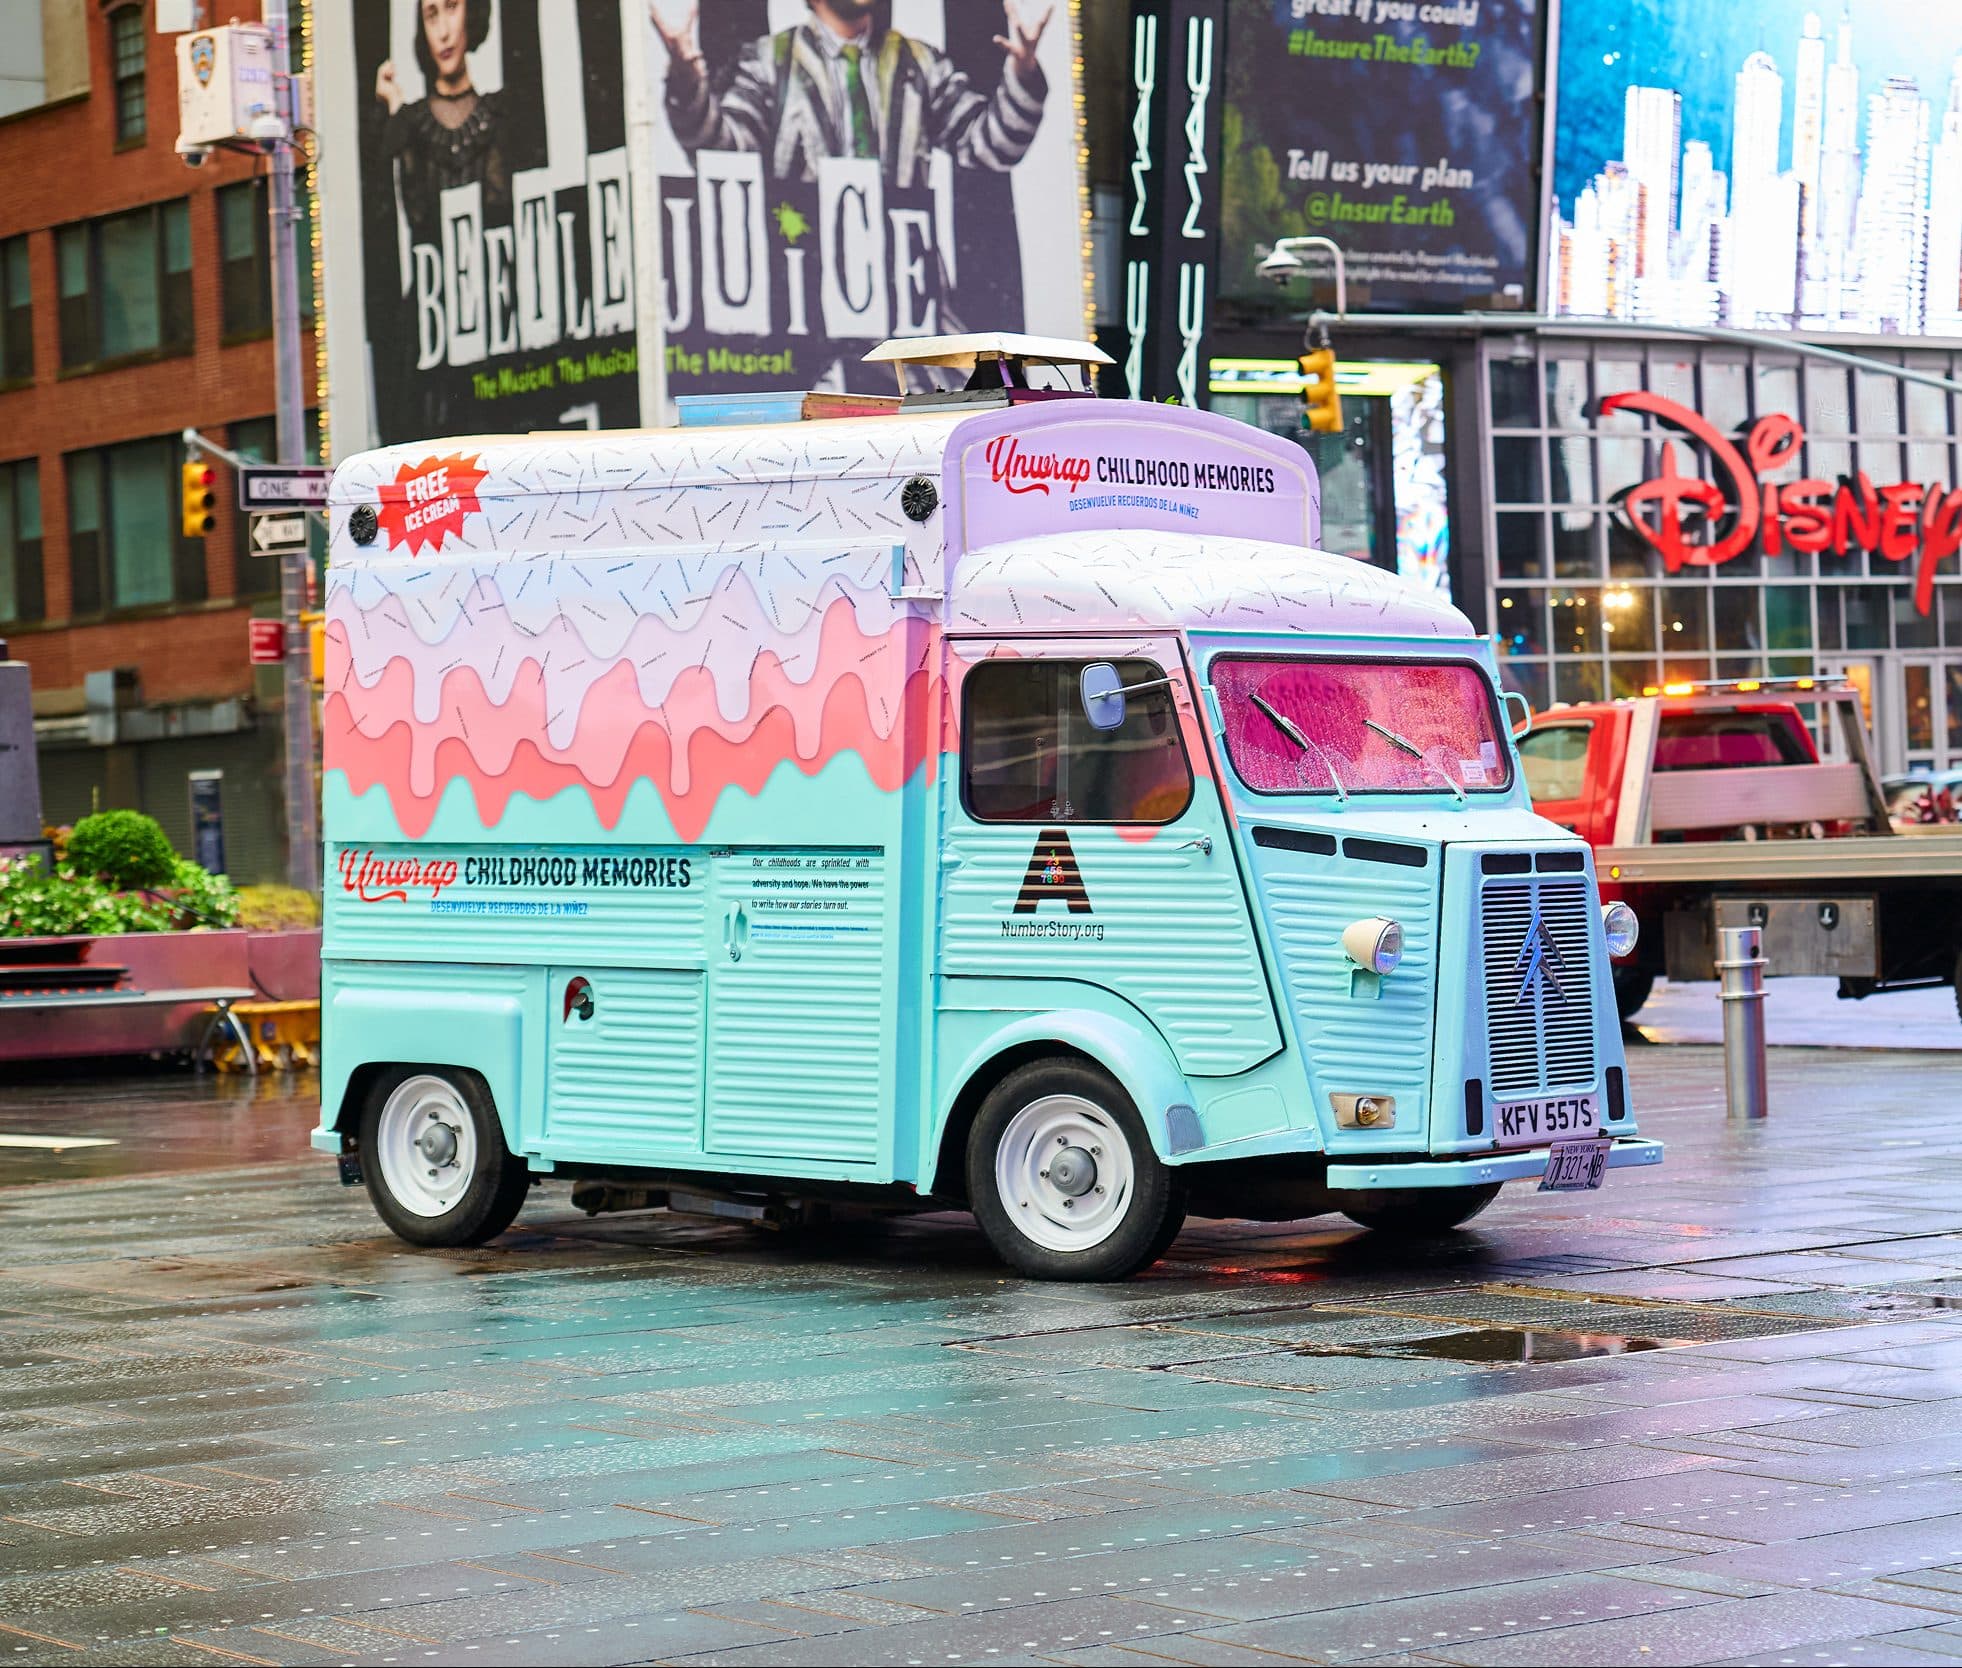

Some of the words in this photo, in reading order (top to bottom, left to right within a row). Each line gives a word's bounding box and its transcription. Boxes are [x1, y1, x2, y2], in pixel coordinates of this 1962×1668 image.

[1291, 0, 1350, 19] great
[1355, 0, 1370, 22] if
[1374, 2, 1415, 23] you
[1420, 1, 1479, 26] could
[1288, 29, 1480, 68] #InsureTheEarth?
[1288, 150, 1329, 180] Tell
[1331, 161, 1359, 183] us
[1363, 164, 1419, 189] your
[1420, 159, 1473, 191] plan
[1307, 193, 1455, 226] @InsurEarth
[413, 178, 626, 370] BEETLE
[473, 371, 498, 400] The
[557, 356, 585, 383] The
[665, 346, 703, 375] The
[985, 434, 1091, 496] Unwrap
[1097, 456, 1190, 488] CHILDHOOD
[1194, 463, 1275, 493] MEMORIES
[258, 480, 291, 498] ONE
[308, 481, 329, 496] WA
[405, 467, 450, 509] FREE
[404, 512, 424, 533] ICE
[423, 495, 461, 523] CREAM
[1069, 495, 1117, 512] DESENVUELVE
[1117, 495, 1157, 509] RECUERDOS
[1159, 499, 1168, 511] DE
[1169, 502, 1178, 513] LA
[1179, 502, 1199, 519] NIÑEZ
[752, 858, 763, 867] Our
[768, 858, 801, 867] childhoods
[821, 858, 850, 869] sprinkled
[855, 858, 870, 867] with
[1046, 857, 1060, 866] 23
[1049, 849, 1056, 857] 1
[338, 848, 457, 903] Unwrap
[464, 857, 577, 887] CHILDHOOD
[582, 857, 691, 888] MEMORIES
[1040, 875, 1065, 884] 7890
[1044, 866, 1063, 875] 456
[752, 879, 780, 889] adversity
[782, 880, 793, 888] and
[794, 880, 811, 890] hope.
[811, 880, 822, 888] We
[823, 880, 838, 888] have
[839, 880, 849, 888] the
[850, 881, 869, 890] power
[431, 901, 487, 914] DESENVUELVE
[488, 901, 537, 915] RECUERDOS
[538, 902, 549, 914] DE
[550, 902, 562, 914] LA
[563, 899, 588, 915] NIÑEZ
[751, 900, 758, 908] to
[758, 900, 774, 909] write
[775, 900, 788, 909] how
[800, 900, 822, 909] stories
[823, 901, 836, 909] turn
[837, 901, 849, 910] out.
[1001, 921, 1104, 941] NumberStory.org
[1501, 1104, 1538, 1136] KFV
[1545, 1099, 1592, 1131] 557S
[1565, 1145, 1580, 1154] NEW
[1580, 1144, 1596, 1153] YORK
